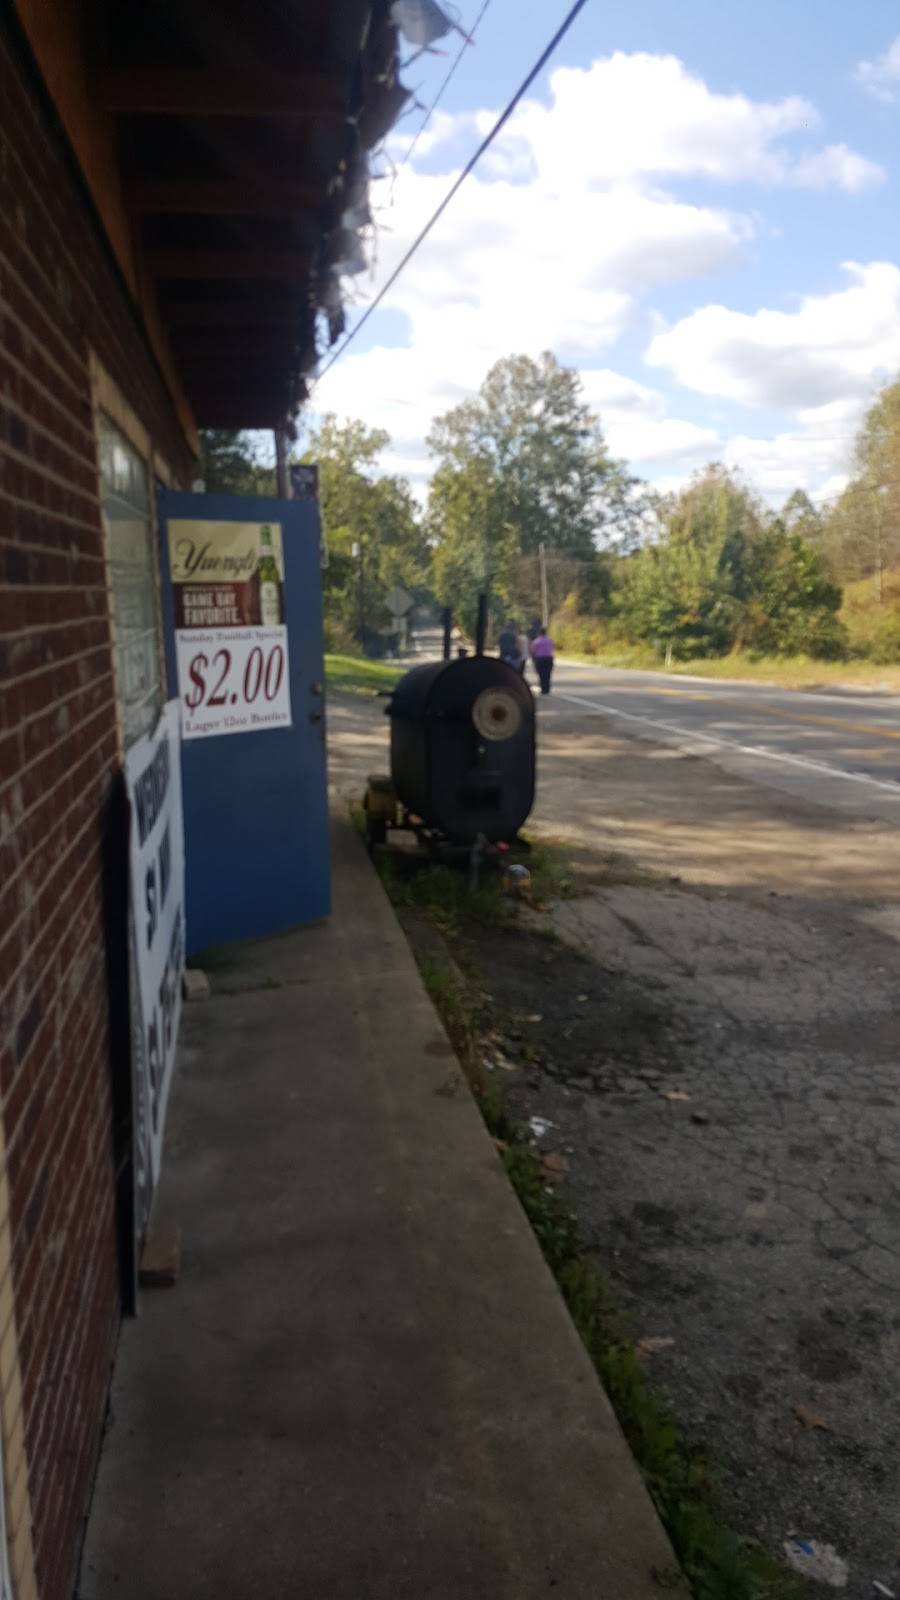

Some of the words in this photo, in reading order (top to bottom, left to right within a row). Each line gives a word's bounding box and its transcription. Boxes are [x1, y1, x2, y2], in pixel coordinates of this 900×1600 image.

[185, 644, 284, 717] $2.00
[185, 721, 220, 733] Lager
[251, 712, 287, 724] Bottles
